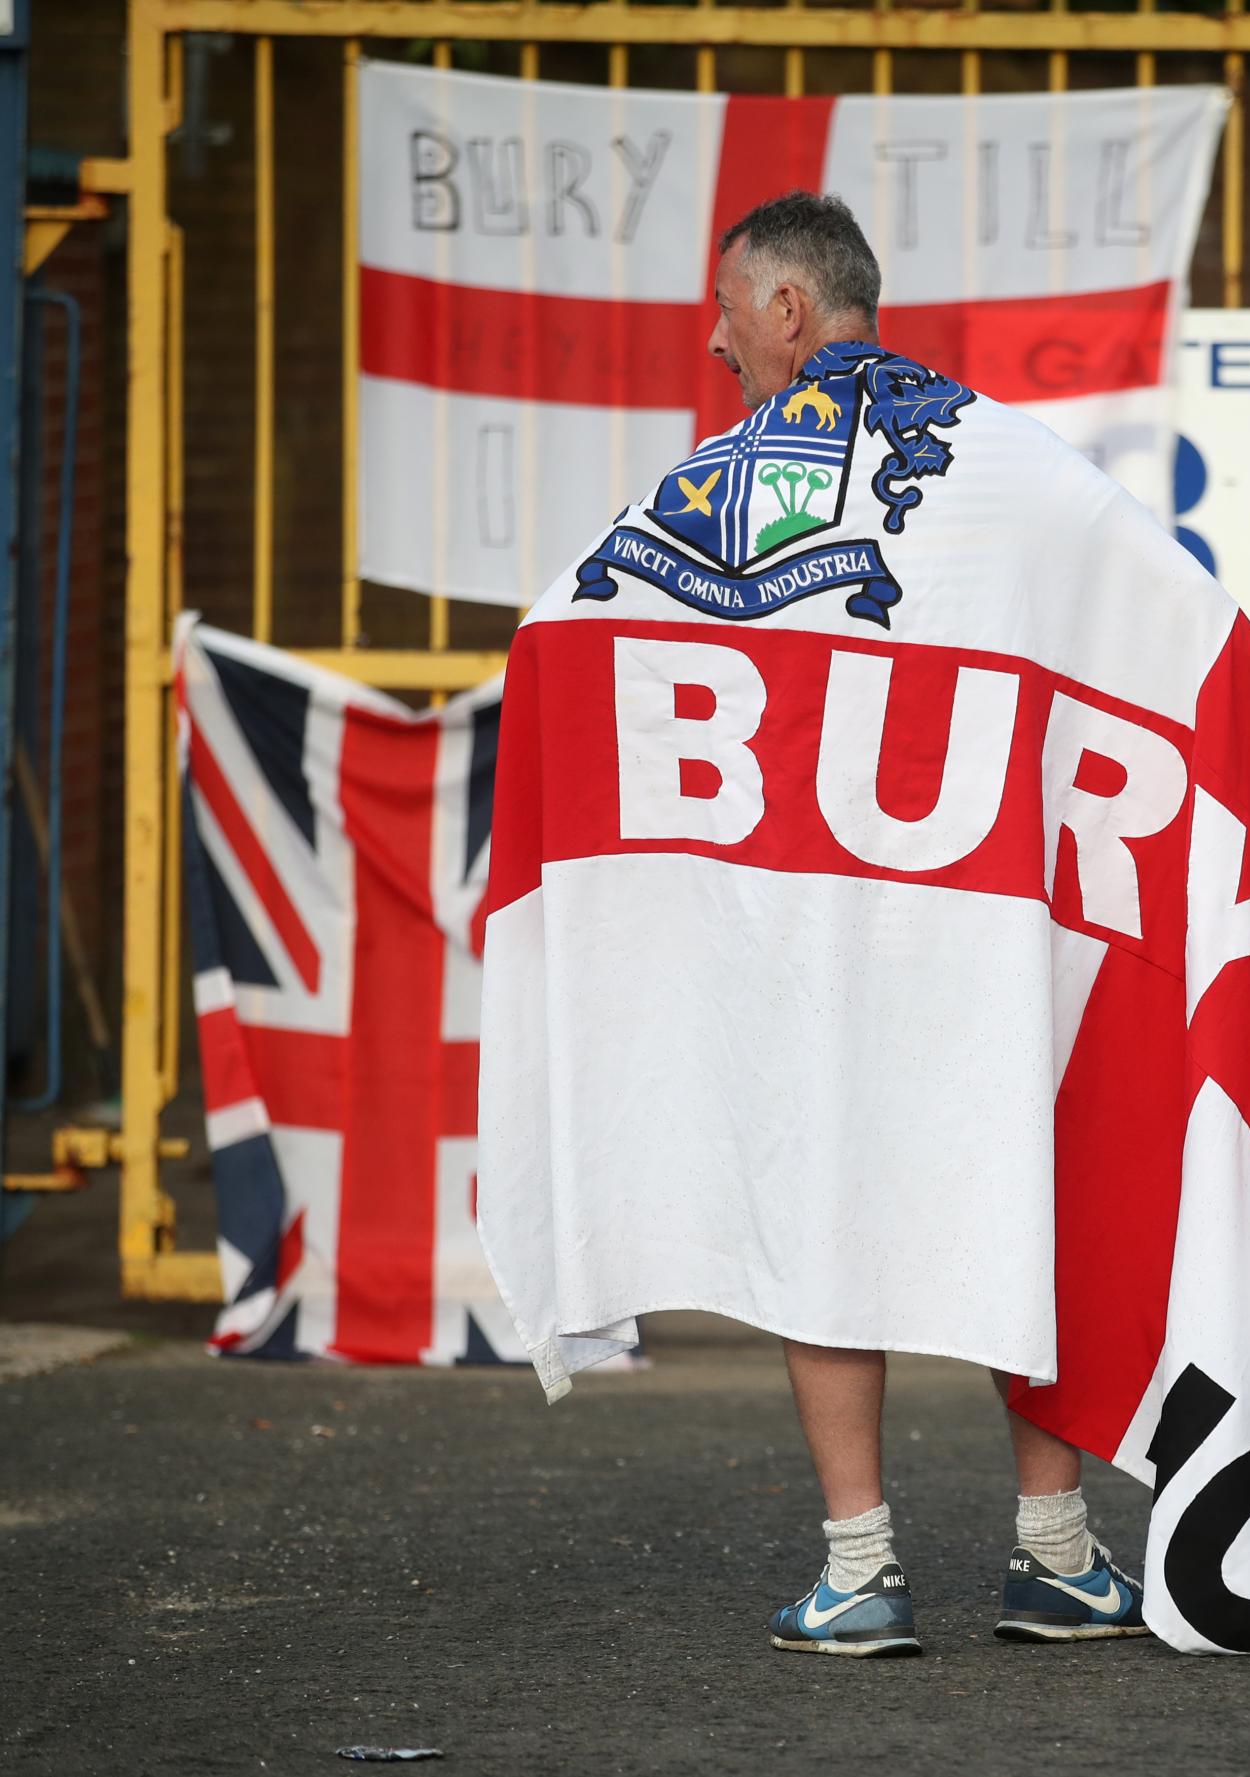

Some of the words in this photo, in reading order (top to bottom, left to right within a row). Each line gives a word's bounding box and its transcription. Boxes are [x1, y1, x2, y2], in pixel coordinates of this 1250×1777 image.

[409, 128, 675, 245] BURY
[874, 138, 1151, 251] TILL
[612, 535, 678, 578] VINCIT
[677, 571, 746, 609] OMNIA
[758, 550, 872, 606] INDUSTRIA
[882, 1574, 906, 1588] NIKE
[1009, 1558, 1031, 1572] NIKE
